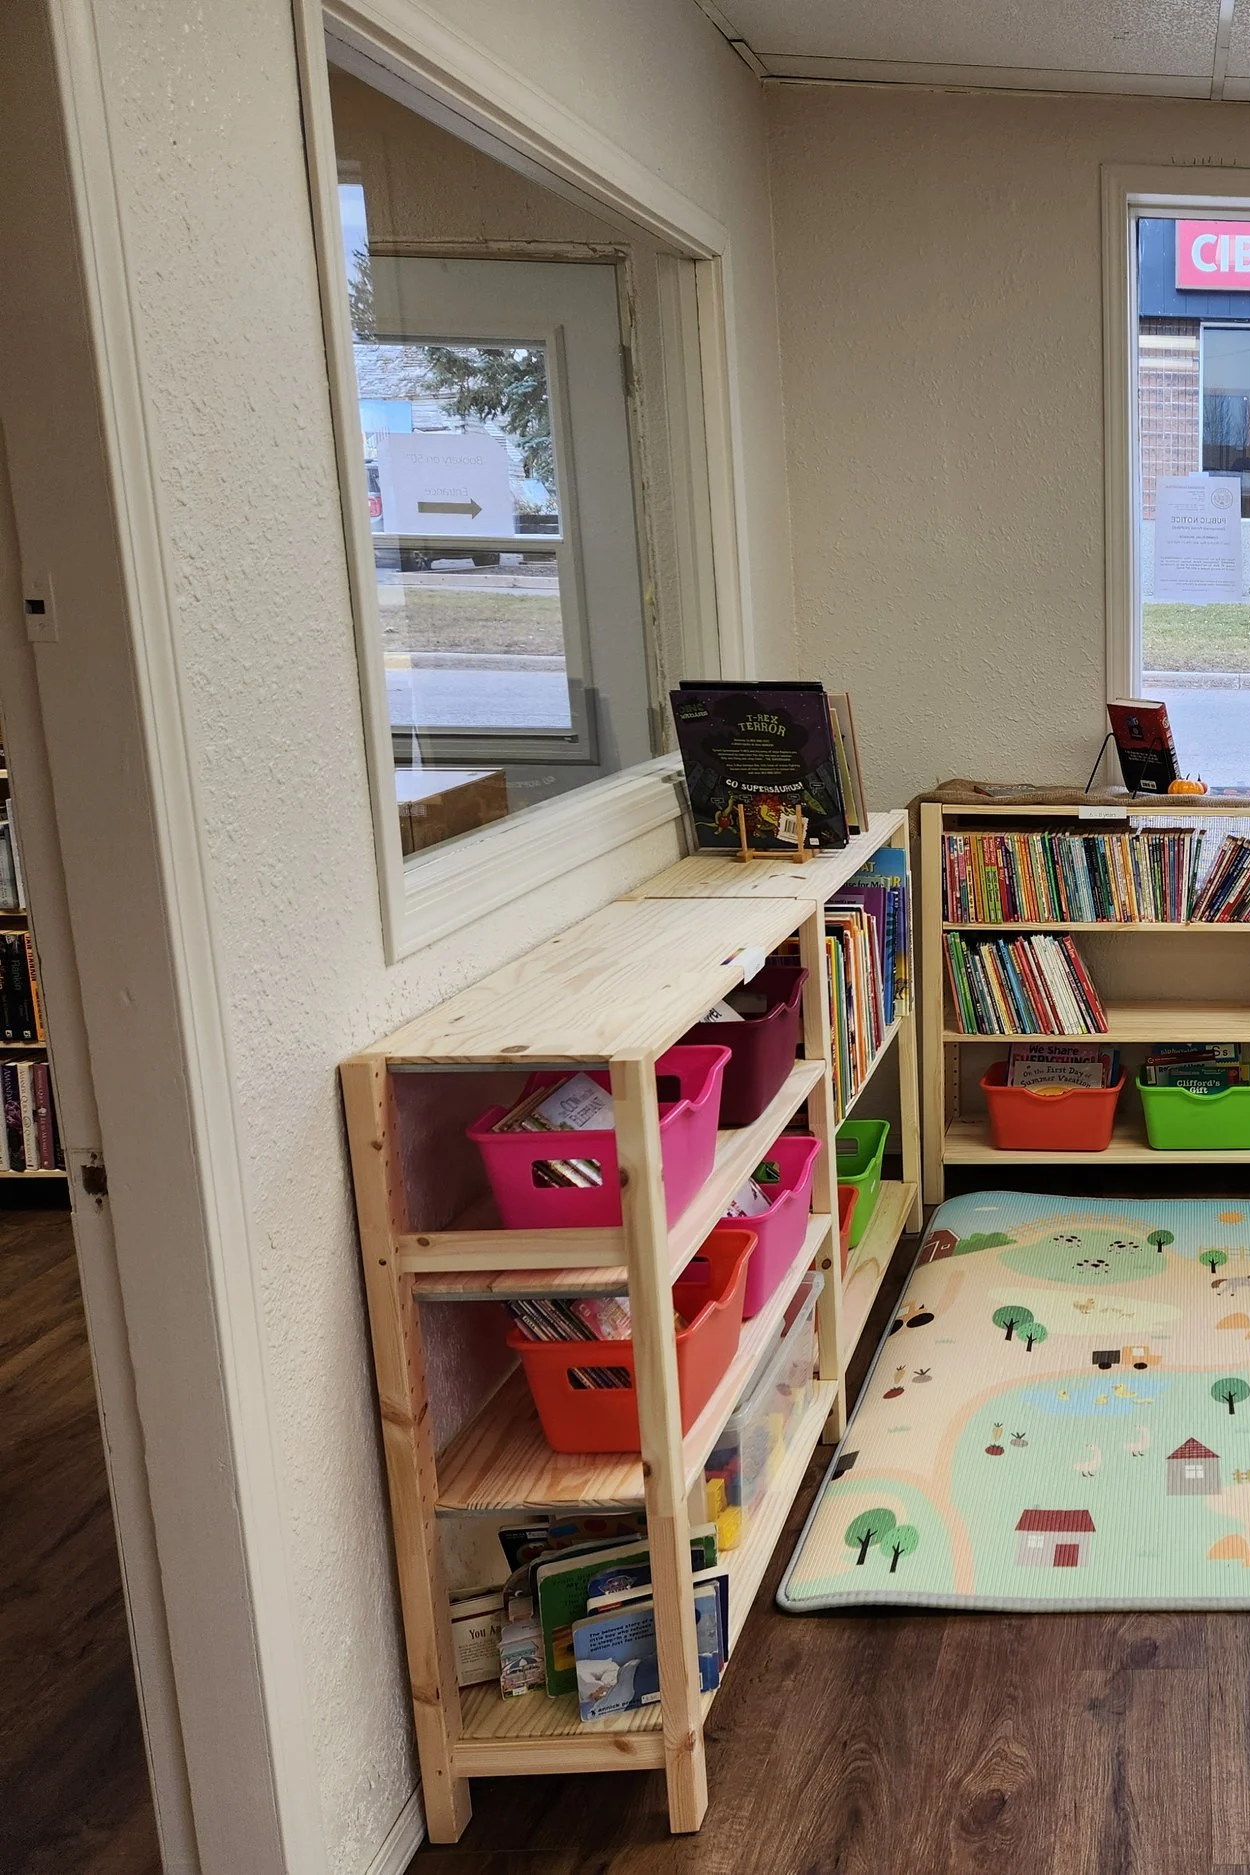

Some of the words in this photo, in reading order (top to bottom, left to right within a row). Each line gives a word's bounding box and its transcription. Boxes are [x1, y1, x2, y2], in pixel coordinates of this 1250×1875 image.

[747, 714, 778, 724] T-REX
[738, 722, 786, 736] TERROR
[741, 781, 804, 793] SUPERSAURUS!
[12, 960, 22, 990] Rankin
[1029, 1045, 1044, 1055] We
[1048, 1044, 1079, 1056] Share
[1046, 1065, 1066, 1074] First
[1068, 1067, 1084, 1078] Day
[4, 1068, 14, 1100] AMANDA
[1020, 1076, 1055, 1088] Summer
[1058, 1075, 1092, 1088] Vacation
[1190, 1086, 1208, 1094] Gift
[468, 1627, 486, 1640] You
[601, 1627, 624, 1636] beloved
[624, 1622, 640, 1632] story
